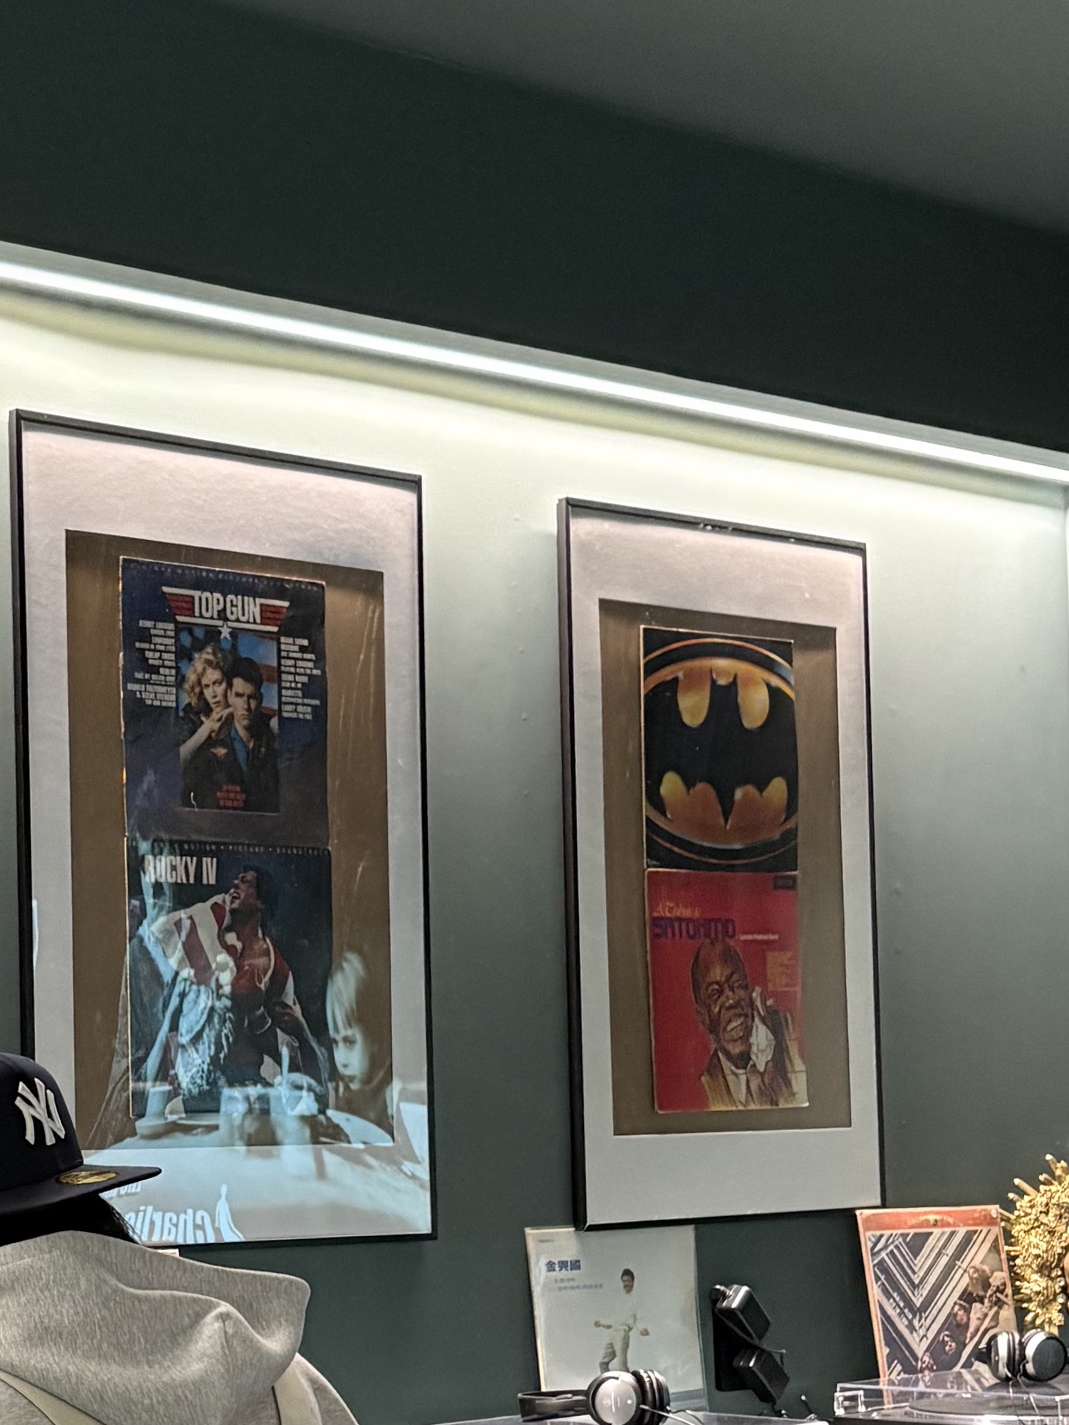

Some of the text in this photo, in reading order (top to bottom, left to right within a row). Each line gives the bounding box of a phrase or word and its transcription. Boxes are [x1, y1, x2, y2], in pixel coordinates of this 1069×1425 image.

[192, 591, 261, 624] TOP GUN
[144, 855, 217, 885] ROCKY IV
[14, 1077, 65, 1146] NY
